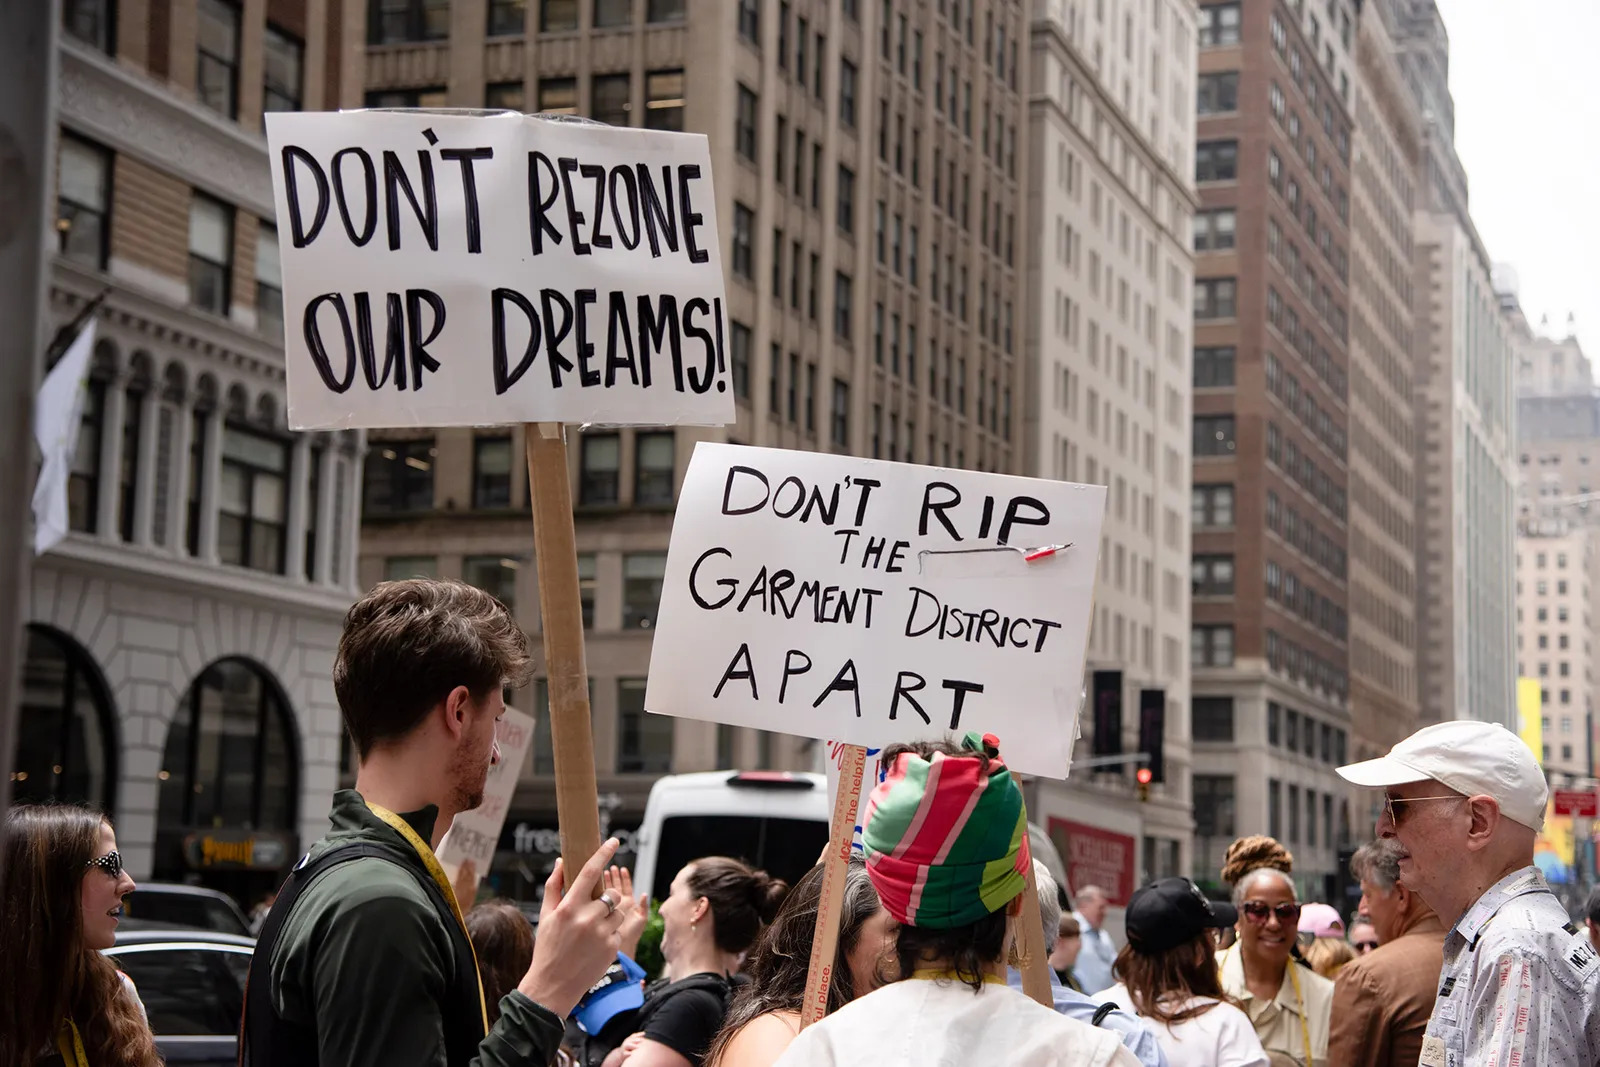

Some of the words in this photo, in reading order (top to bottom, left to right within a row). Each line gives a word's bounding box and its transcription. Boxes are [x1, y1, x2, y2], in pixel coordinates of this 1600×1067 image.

[281, 127, 494, 255] DON'T
[527, 150, 710, 264] REZONE
[302, 288, 447, 395] OUR
[491, 287, 727, 396] DREAMS!
[721, 465, 882, 527] DON'T
[918, 481, 1051, 546] RIP
[834, 529, 911, 573] THE
[688, 547, 883, 629] GARMENT
[904, 586, 1062, 653] DISTRICT
[712, 642, 984, 731] APART
[852, 748, 866, 796] helpful
[845, 799, 858, 824] The
[839, 837, 852, 864] ACE
[817, 964, 831, 1004] place.
